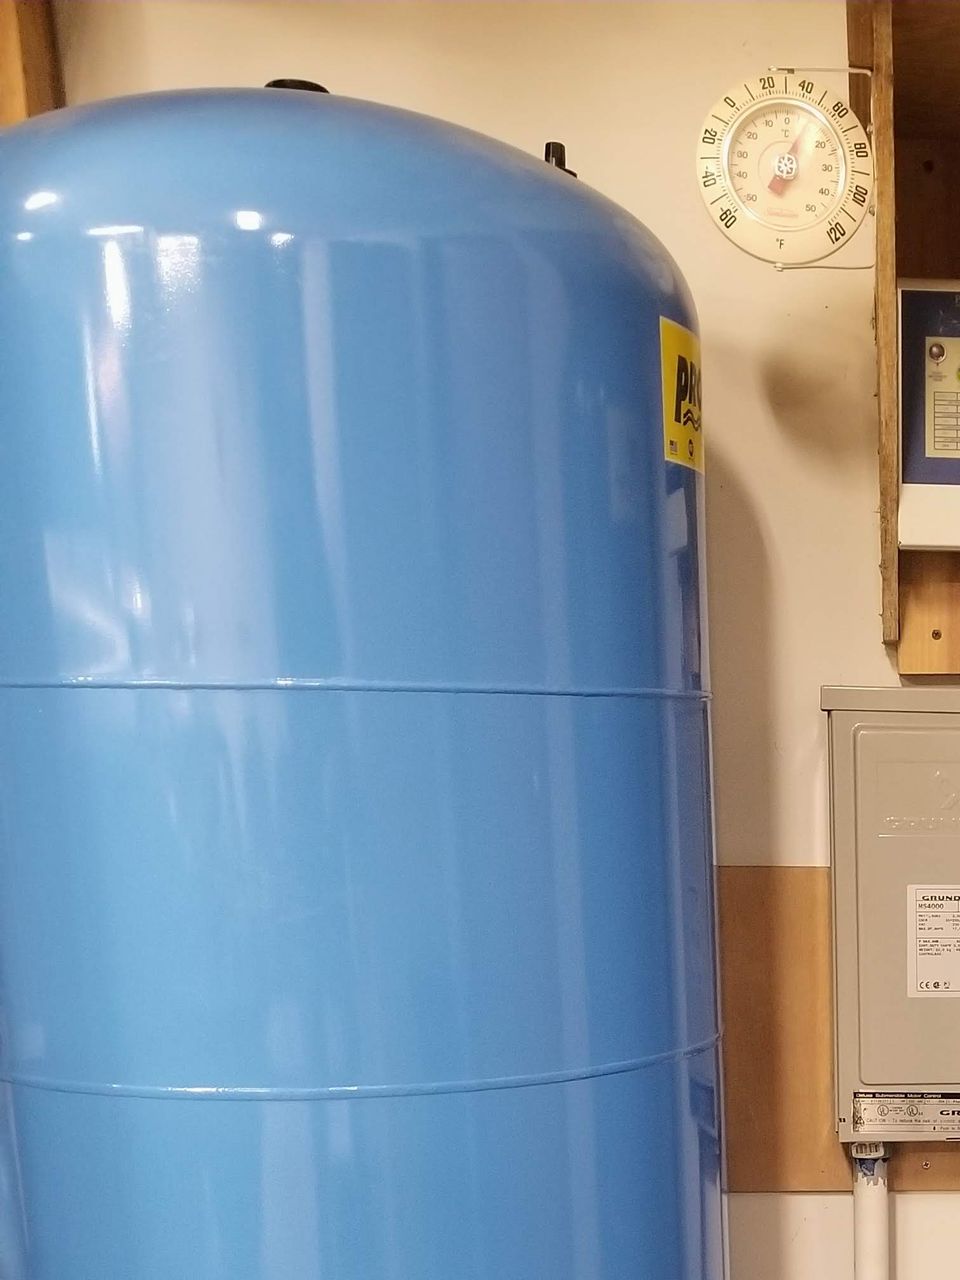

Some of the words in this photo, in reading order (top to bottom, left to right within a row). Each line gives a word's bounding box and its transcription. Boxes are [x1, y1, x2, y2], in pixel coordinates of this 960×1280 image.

[760, 76, 775, 90] 20
[798, 79, 814, 94] 40
[724, 96, 736, 108] 0
[832, 101, 849, 119] 60
[815, 141, 826, 149] 20
[853, 142, 868, 158] 80
[822, 164, 833, 172] 30
[819, 188, 830, 196] 40
[852, 185, 868, 207] 100
[805, 204, 816, 212] 50
[826, 222, 846, 245] 120
